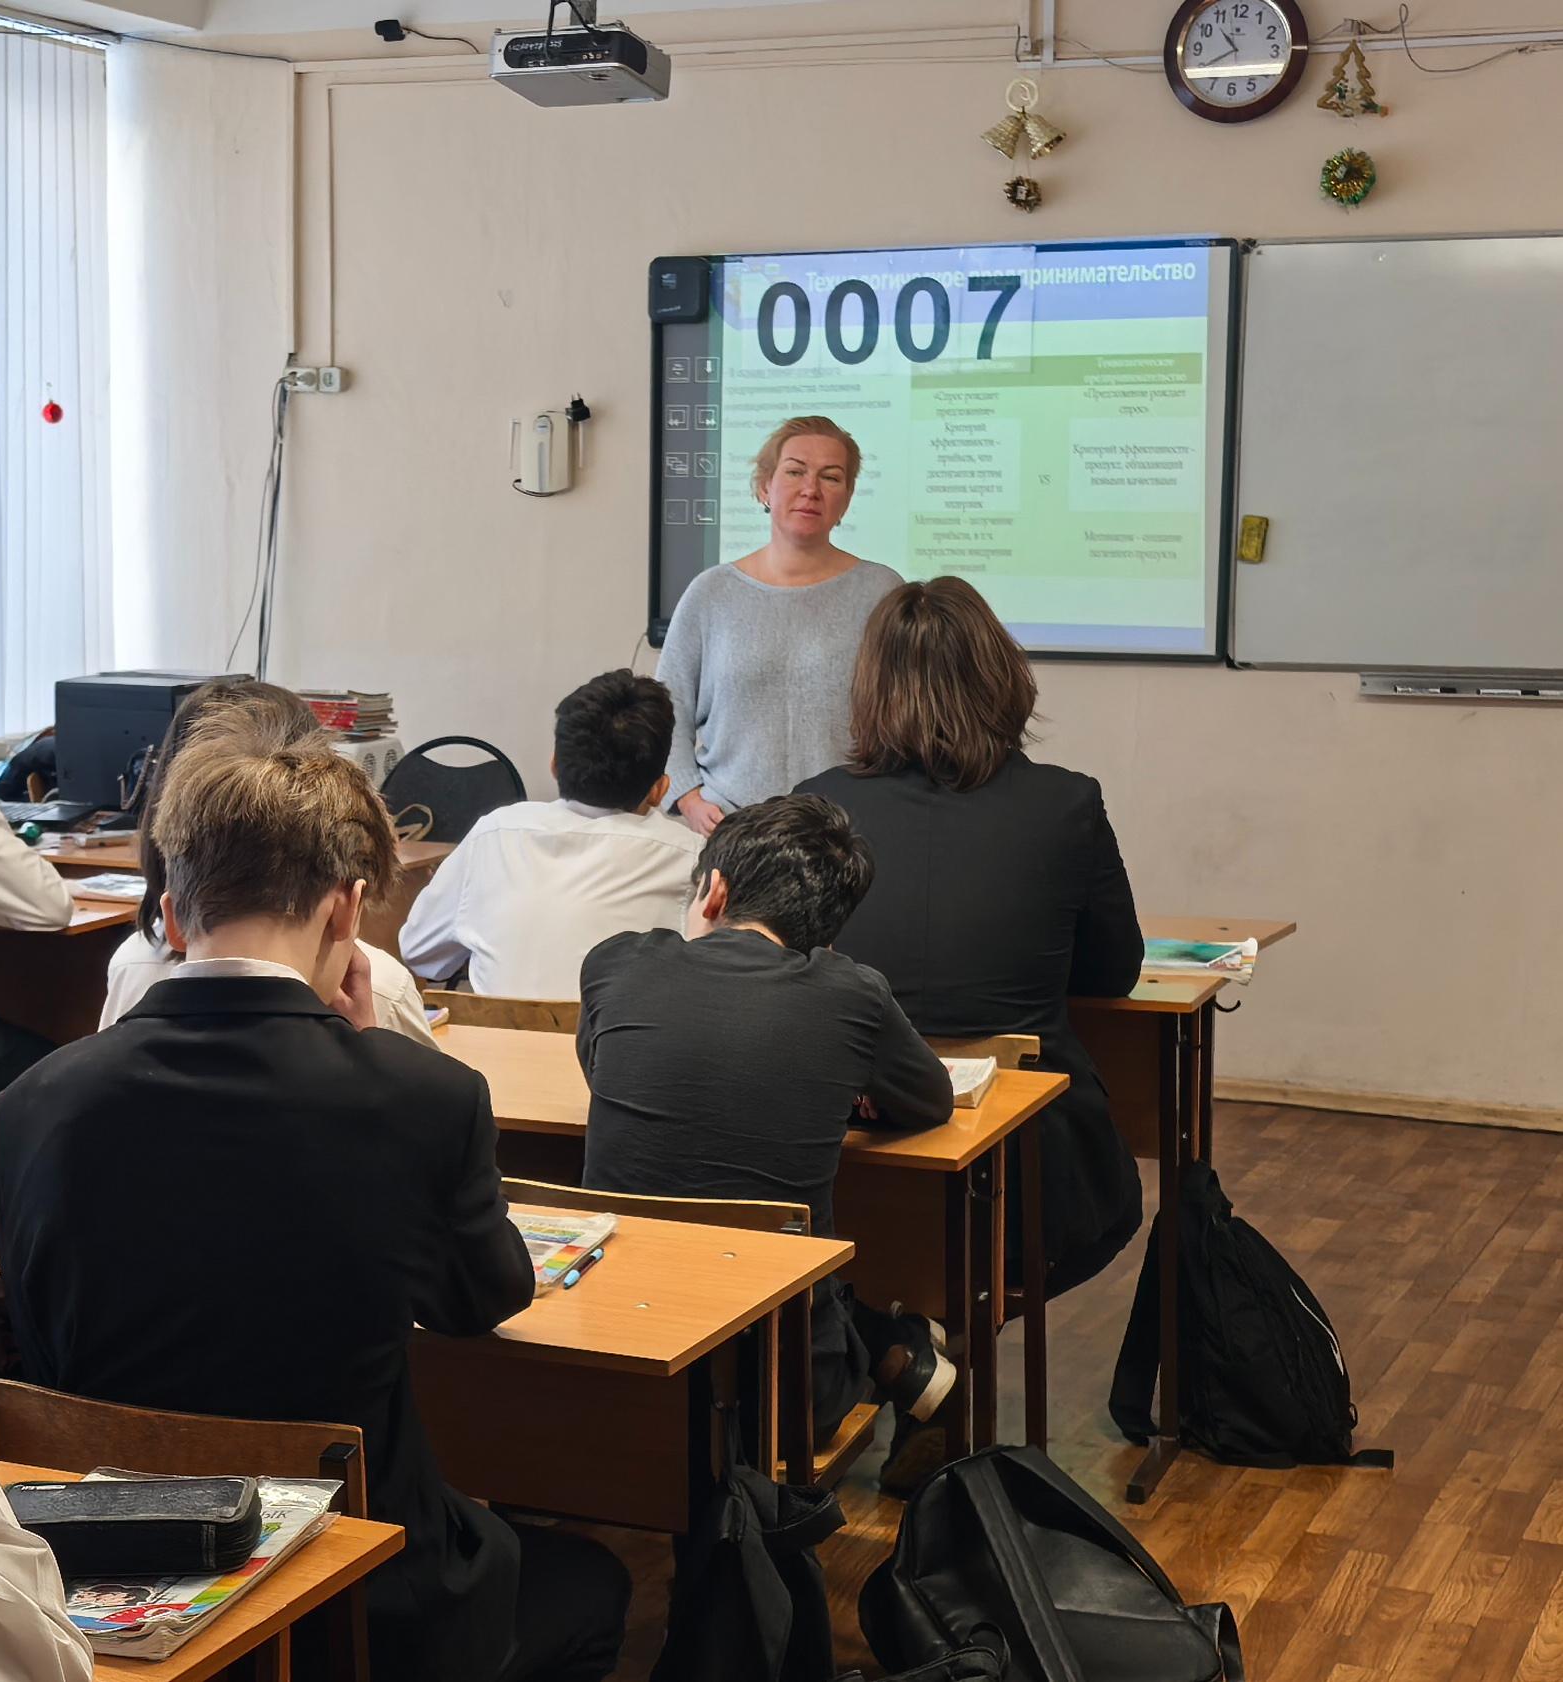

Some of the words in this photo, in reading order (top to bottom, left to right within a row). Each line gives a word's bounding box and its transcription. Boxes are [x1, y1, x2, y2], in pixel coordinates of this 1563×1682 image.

[1214, 9, 1226, 24] 11
[1231, 4, 1249, 18] 12
[1255, 11, 1263, 25] 1
[1199, 23, 1213, 38] 10
[1266, 25, 1277, 40] 2
[1193, 42, 1203, 56] 9
[1270, 44, 1280, 58] 3
[1227, 82, 1237, 96] 6
[1247, 78, 1257, 92] 5
[805, 269, 965, 293] Техогичое
[756, 275, 1022, 366] 0007
